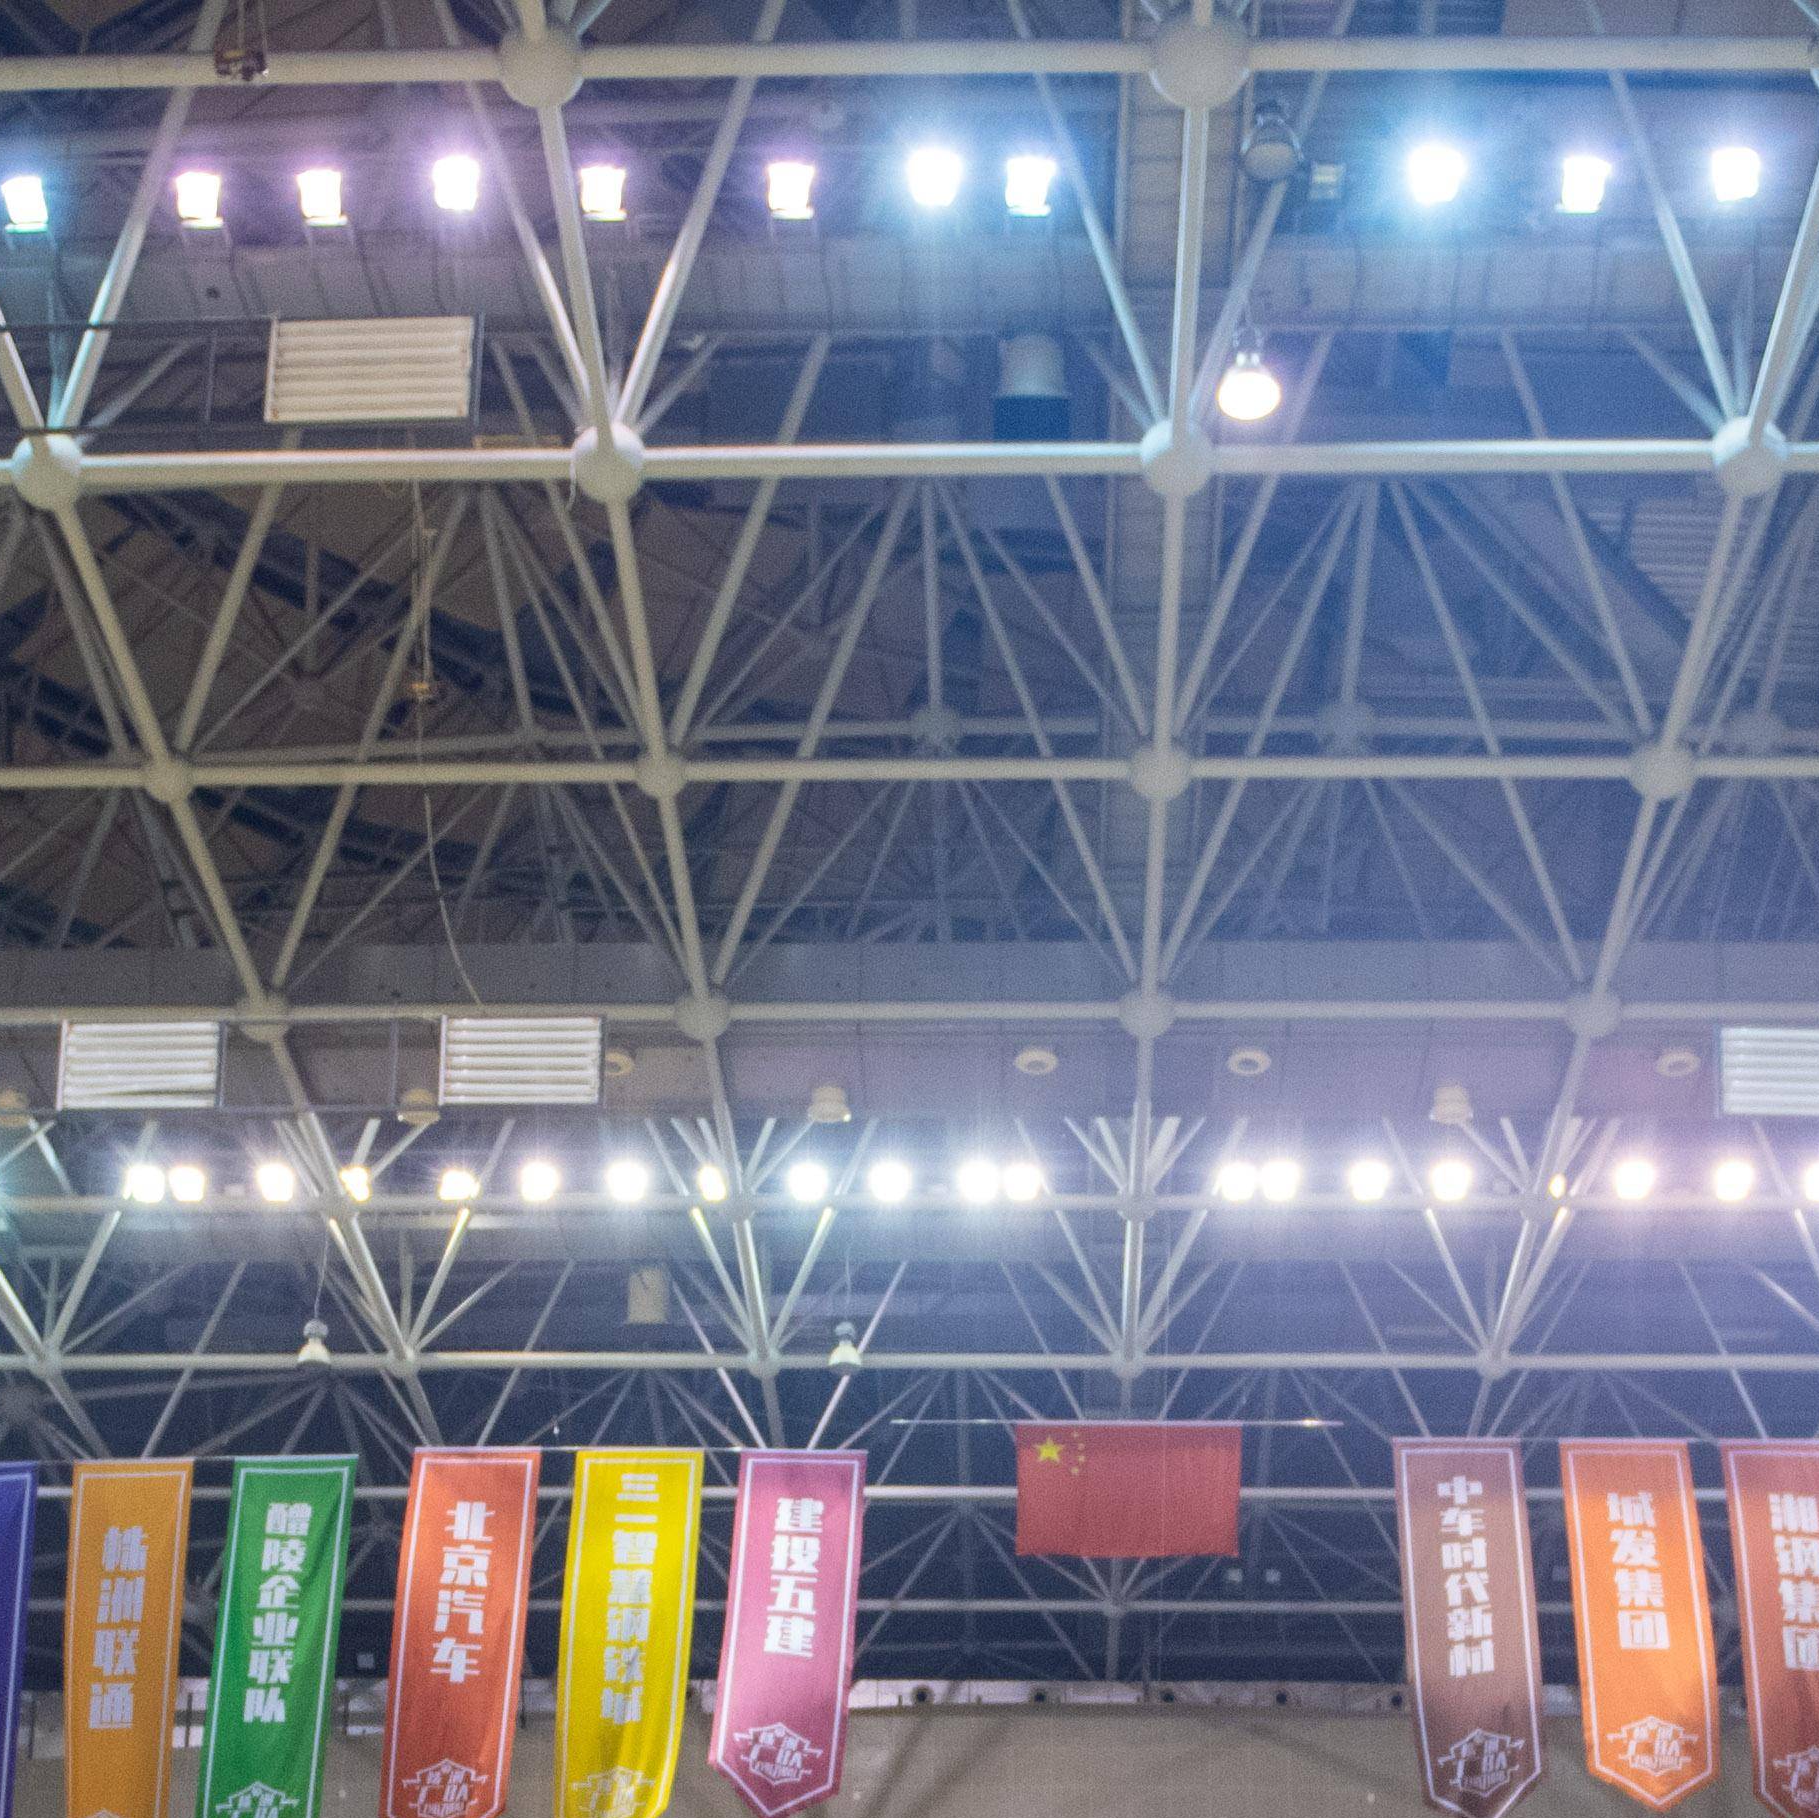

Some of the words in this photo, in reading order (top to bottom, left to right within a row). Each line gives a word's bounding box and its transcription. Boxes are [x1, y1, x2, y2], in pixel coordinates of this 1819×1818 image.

[87, 1525, 148, 1730] 株洲联通
[242, 1502, 312, 1723] 醴陵企业联队
[430, 1501, 496, 1684] 北京汽车
[762, 1496, 815, 1658] 建投五建
[1436, 1475, 1496, 1678] 中车时代新材
[1606, 1490, 1672, 1651] 城发集团
